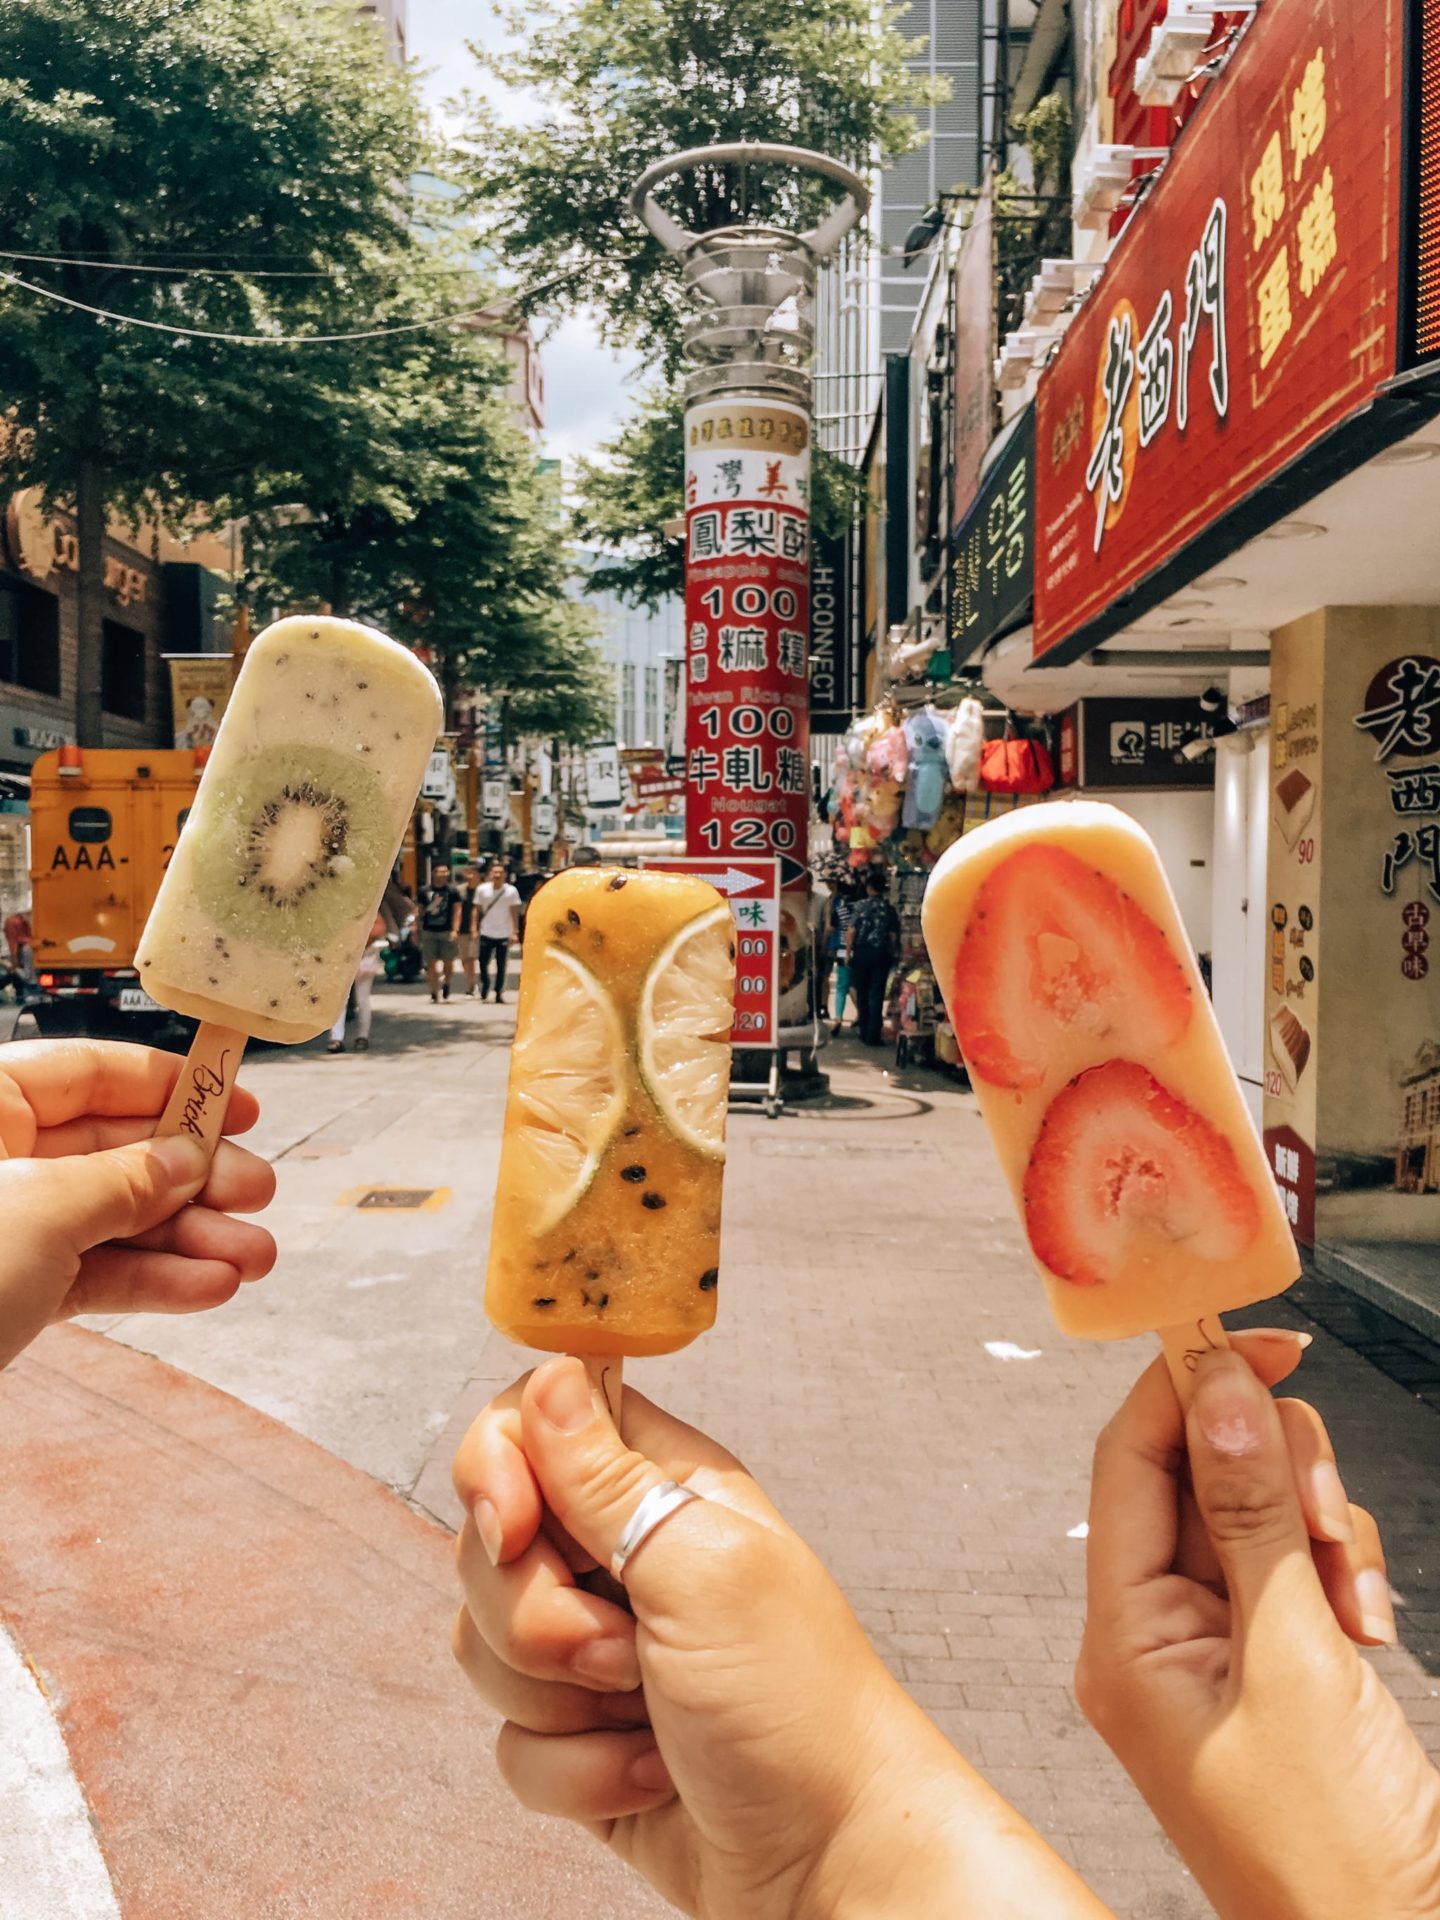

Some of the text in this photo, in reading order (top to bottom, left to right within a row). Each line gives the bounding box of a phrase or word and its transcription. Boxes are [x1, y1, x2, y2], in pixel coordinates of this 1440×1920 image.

[1086, 195, 1229, 555] 老西門
[702, 584, 798, 621] 100
[700, 705, 794, 739] 100
[700, 818, 795, 850] 120
[1298, 839, 1315, 864] 90
[738, 900, 767, 928] 味
[1403, 902, 1429, 979] 古早味
